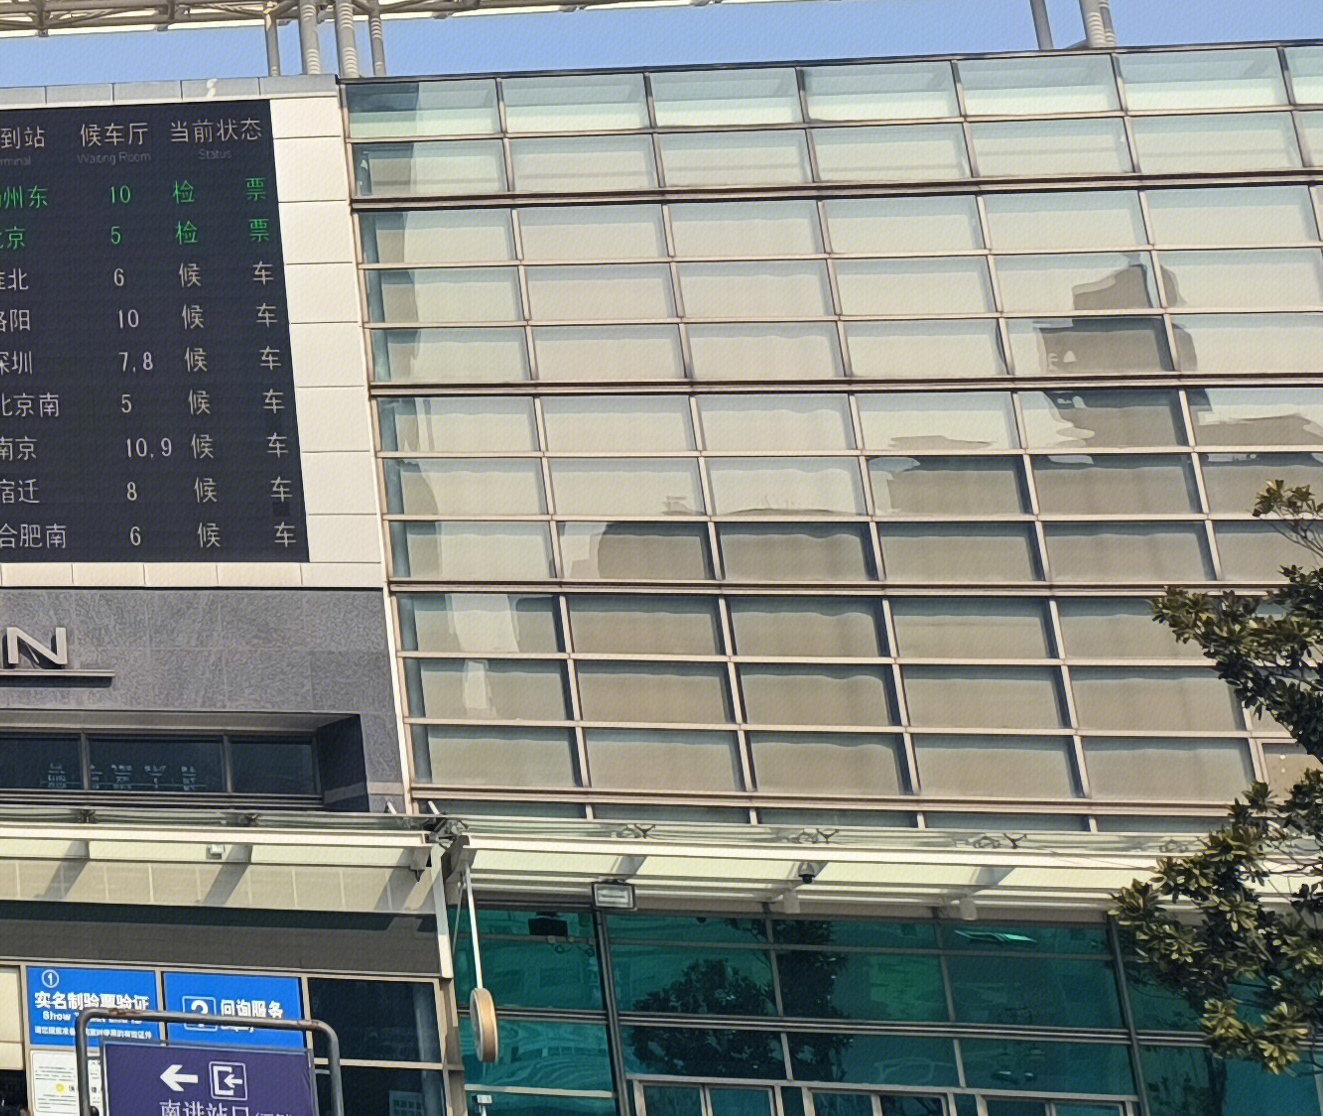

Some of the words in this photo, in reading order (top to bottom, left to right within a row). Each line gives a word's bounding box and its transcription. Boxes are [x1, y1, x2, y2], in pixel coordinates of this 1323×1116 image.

[80, 123, 149, 147] 候车厅
[170, 118, 262, 143] 当前状态
[118, 151, 151, 161] Room
[198, 148, 232, 160] Status
[110, 185, 131, 204] 10
[111, 226, 121, 245] 5
[113, 268, 125, 286] 6
[118, 309, 139, 329] 10
[119, 351, 153, 373] 7,8
[121, 394, 132, 413] 5
[126, 437, 172, 459] 10,9
[126, 481, 138, 501] 8
[129, 526, 141, 546] 6
[42, 1011, 71, 1021] Show
[221, 999, 284, 1018] 问询服务
